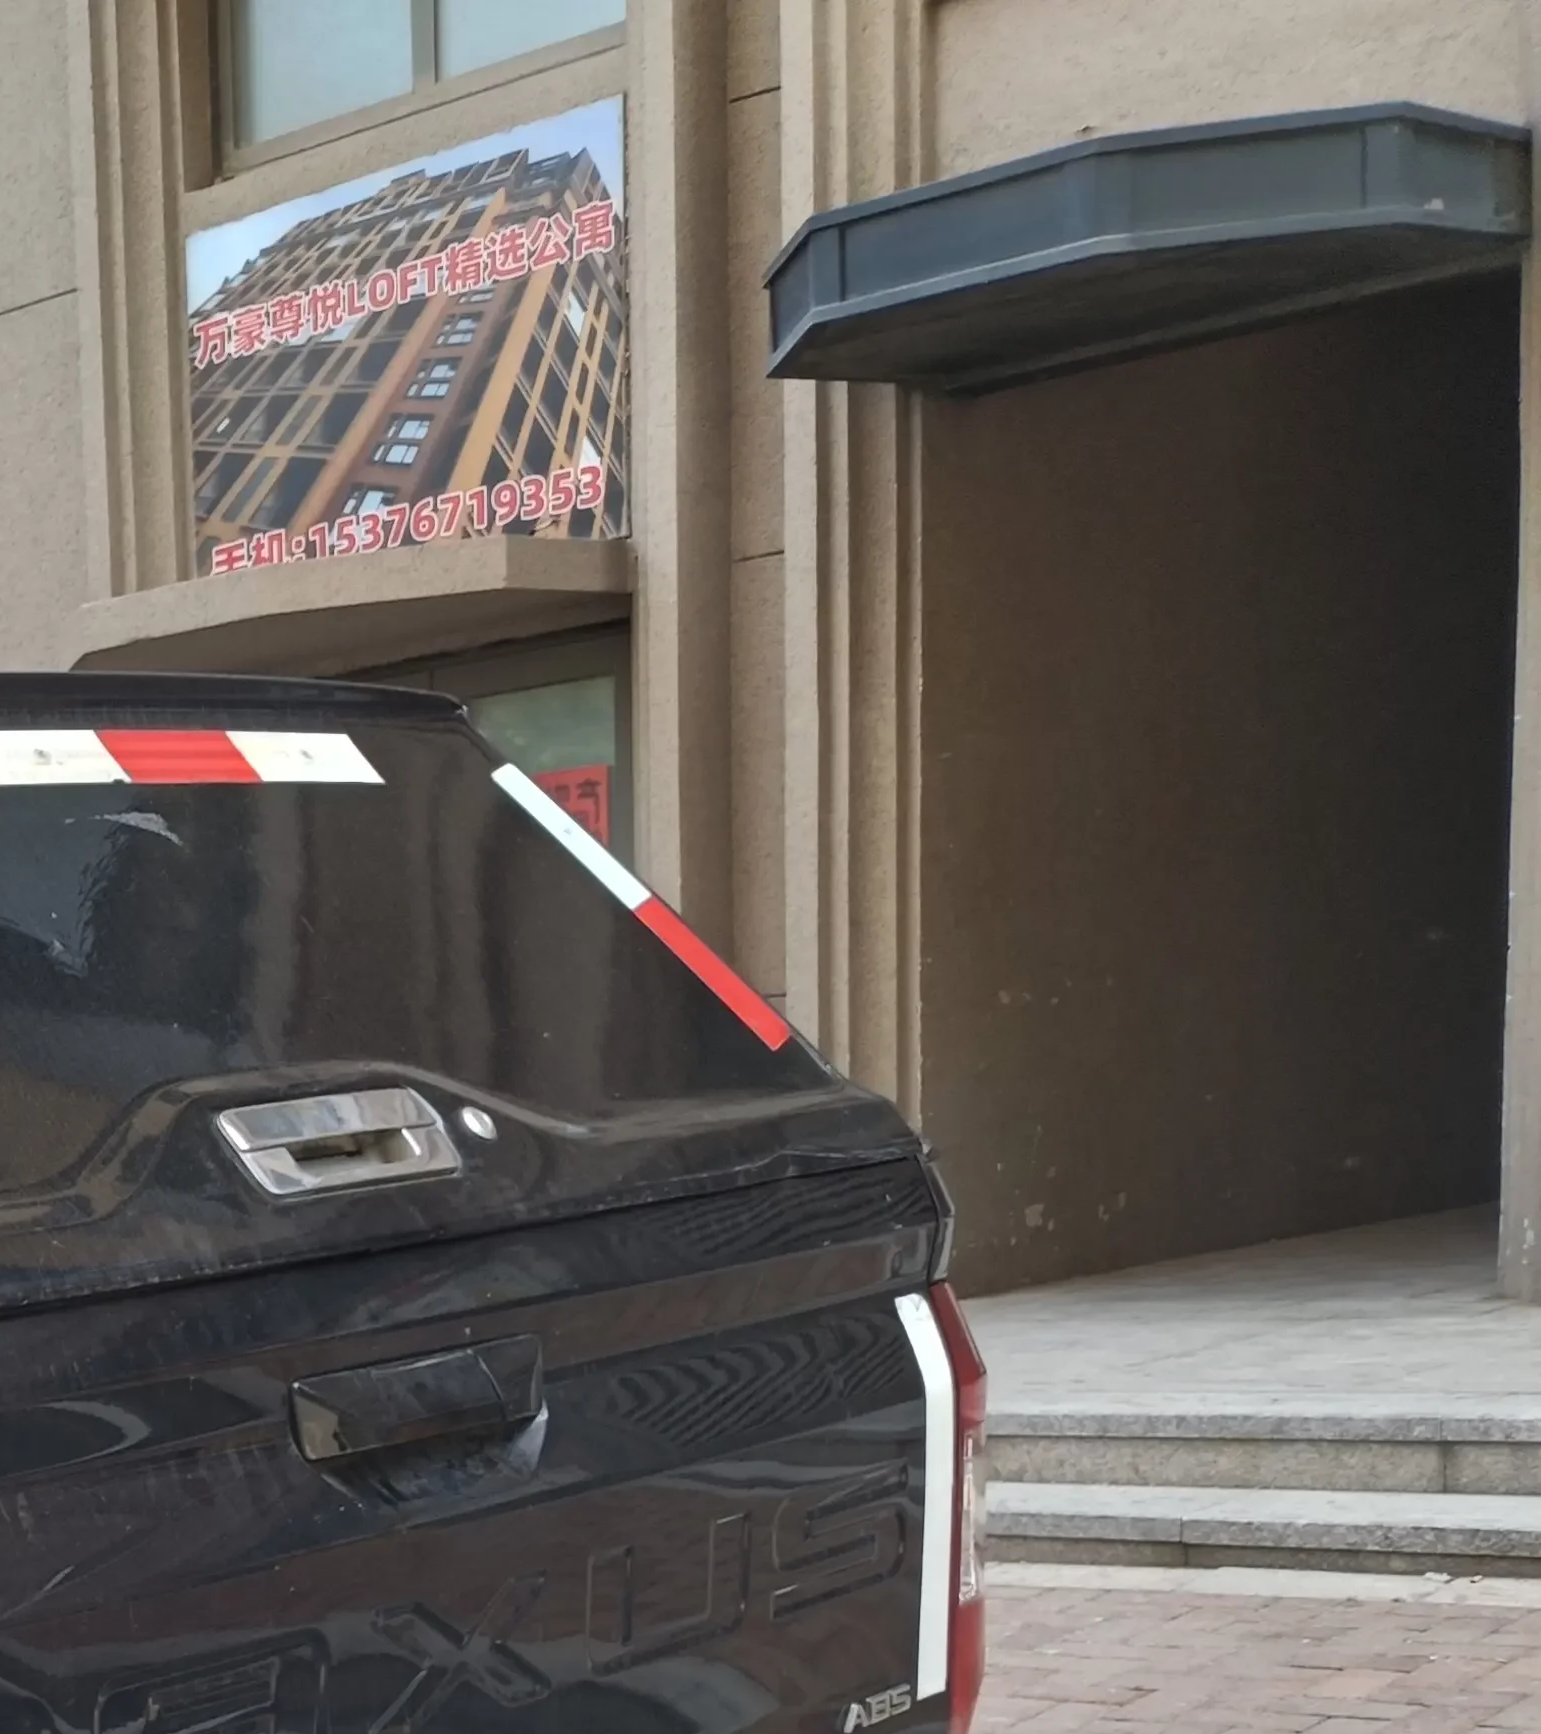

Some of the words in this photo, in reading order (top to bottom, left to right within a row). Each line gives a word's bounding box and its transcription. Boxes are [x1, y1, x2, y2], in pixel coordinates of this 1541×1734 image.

[194, 200, 616, 367] 万豪尊悦LOFT精选公寓
[842, 1683, 911, 1734] ABS
